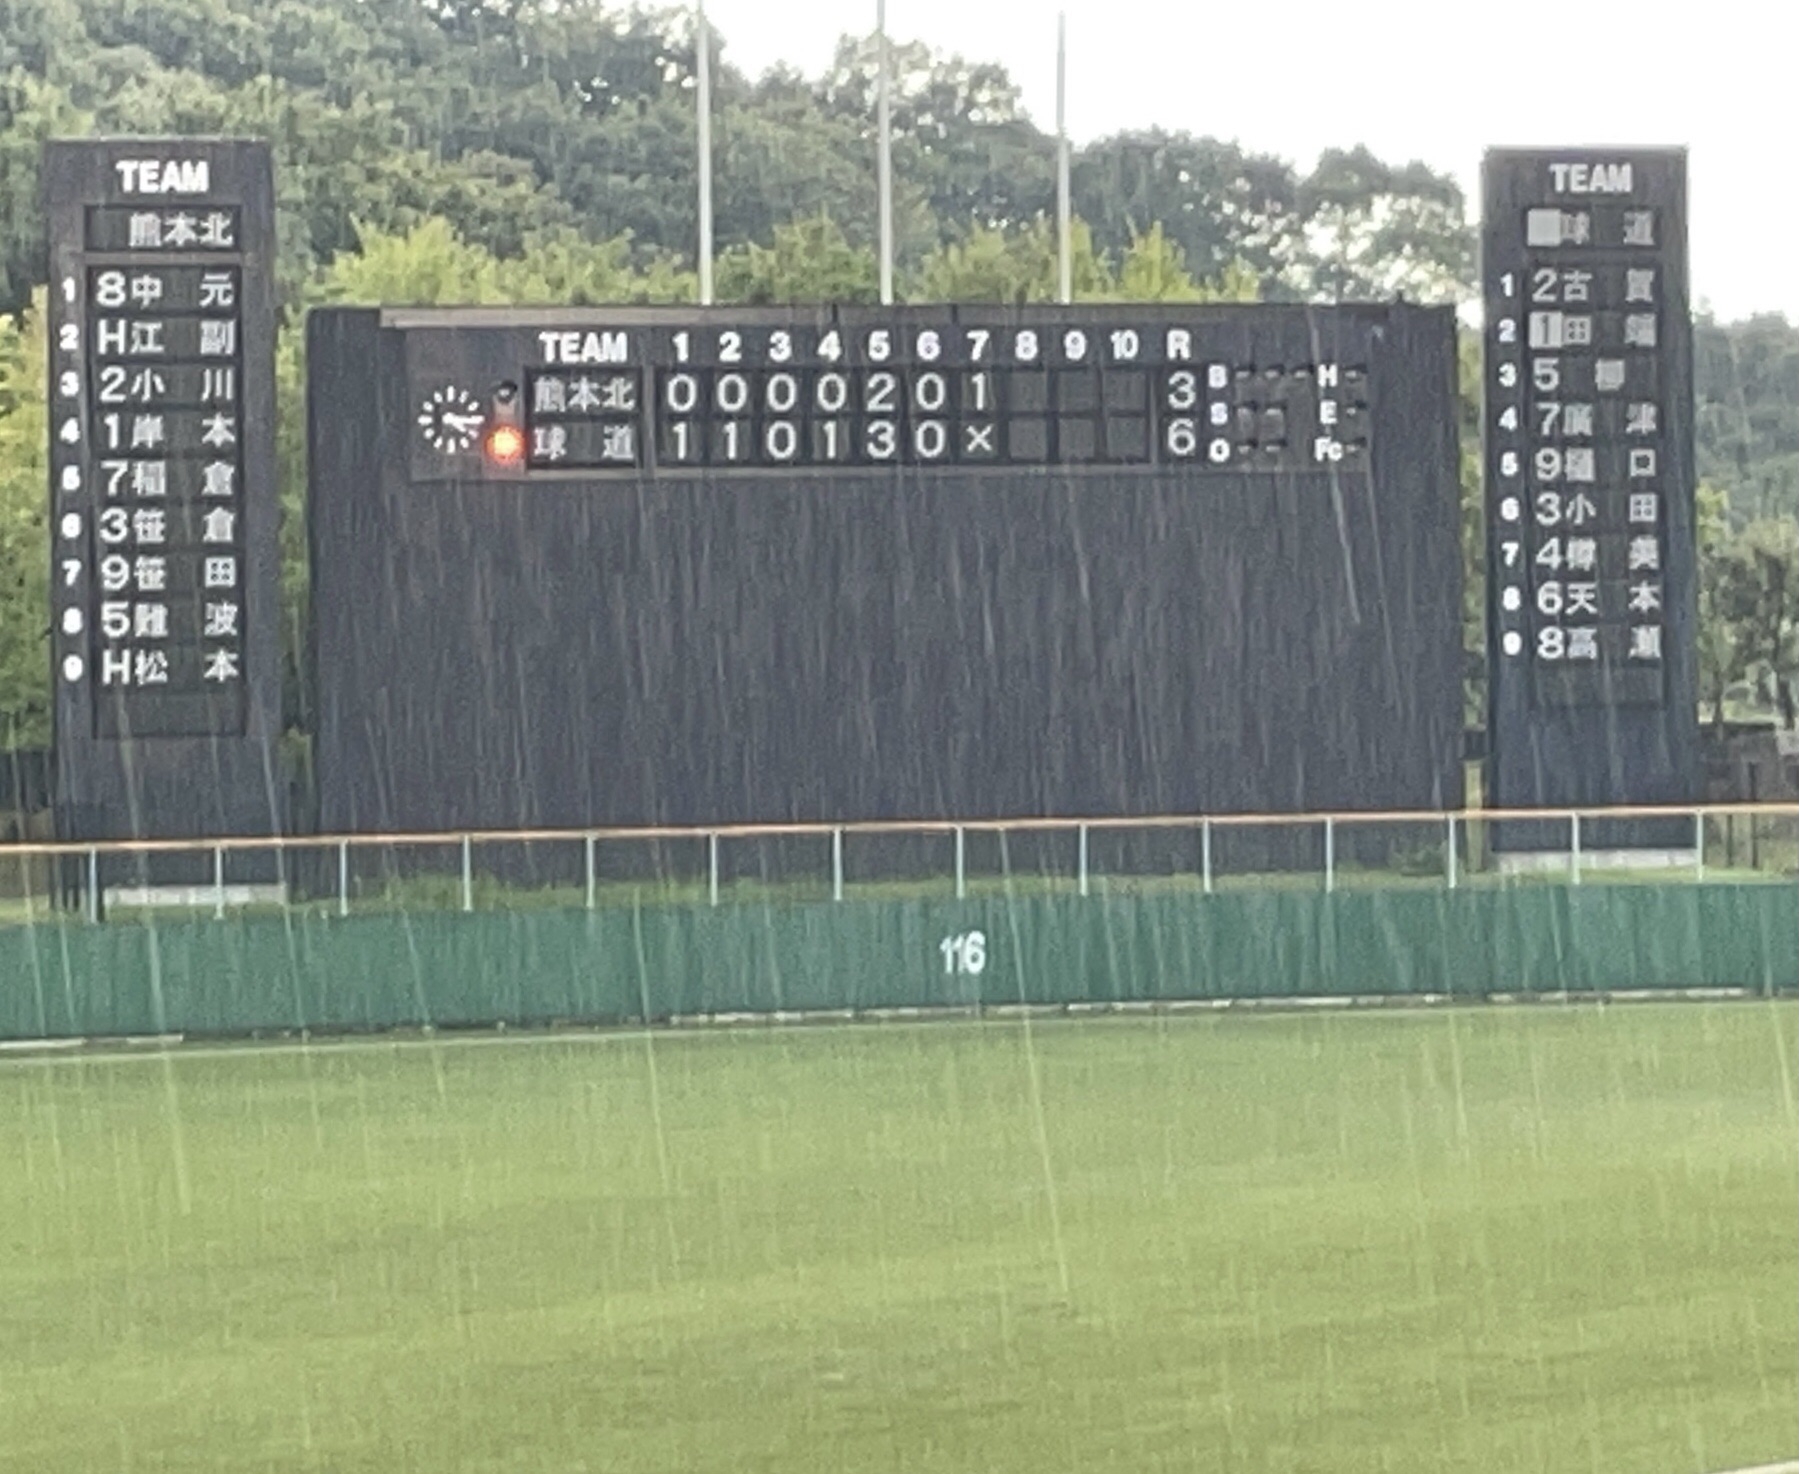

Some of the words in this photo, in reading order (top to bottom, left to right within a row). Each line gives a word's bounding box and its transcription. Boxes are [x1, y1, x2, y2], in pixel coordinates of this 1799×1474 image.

[116, 160, 210, 193] TEAM
[1550, 163, 1633, 193] TEAM
[129, 212, 234, 248] 熊本北
[61, 277, 75, 302] 1
[97, 271, 126, 307] 8
[1501, 273, 1514, 297] 1
[1532, 268, 1557, 302] 2
[60, 324, 79, 349] 2
[98, 319, 126, 354] H
[539, 332, 628, 362] TEAM
[672, 332, 689, 361] 1
[718, 331, 742, 361] 2
[769, 330, 792, 361] 3
[818, 330, 841, 361] 4
[867, 330, 891, 361] 5
[916, 330, 941, 361] 6
[966, 330, 990, 361] 7
[1015, 330, 1038, 360] 8
[1064, 330, 1087, 360] 9
[1110, 329, 1138, 360] 10
[1166, 329, 1191, 360] R
[1499, 319, 1516, 342] 2
[61, 371, 79, 396] 3
[100, 366, 126, 402] 2
[1318, 363, 1338, 387] H
[1499, 362, 1517, 387] 3
[1534, 357, 1559, 391] 5
[534, 376, 635, 412] 熊本北
[667, 374, 697, 412] 0
[717, 374, 747, 412] 0
[767, 374, 796, 411] 0
[817, 373, 846, 411] 0
[866, 373, 895, 412] 2
[915, 373, 945, 411] 0
[971, 373, 987, 410] 1
[1168, 371, 1195, 409] 3
[1319, 400, 1338, 424] E
[1499, 406, 1517, 430] 4
[1536, 402, 1561, 436] 7
[60, 417, 80, 443] 4
[104, 413, 119, 449] 1
[671, 421, 687, 460] 1
[722, 421, 737, 460] 1
[767, 421, 797, 459] 0
[821, 420, 836, 459] 1
[866, 420, 895, 459] 3
[915, 420, 945, 458] 0
[1168, 418, 1195, 455] 6
[1209, 438, 1230, 462] O
[1535, 448, 1562, 481] 9
[101, 460, 128, 496] 7
[100, 507, 128, 543] 3
[1536, 493, 1561, 526] 3
[1502, 542, 1519, 566] 7
[1535, 537, 1561, 571] 4
[62, 559, 81, 585] 7
[101, 555, 129, 591] 9
[1537, 581, 1563, 615] 6
[102, 601, 130, 638] 5
[1537, 626, 1564, 660] 8
[102, 649, 131, 684] H
[939, 930, 986, 975] 116
